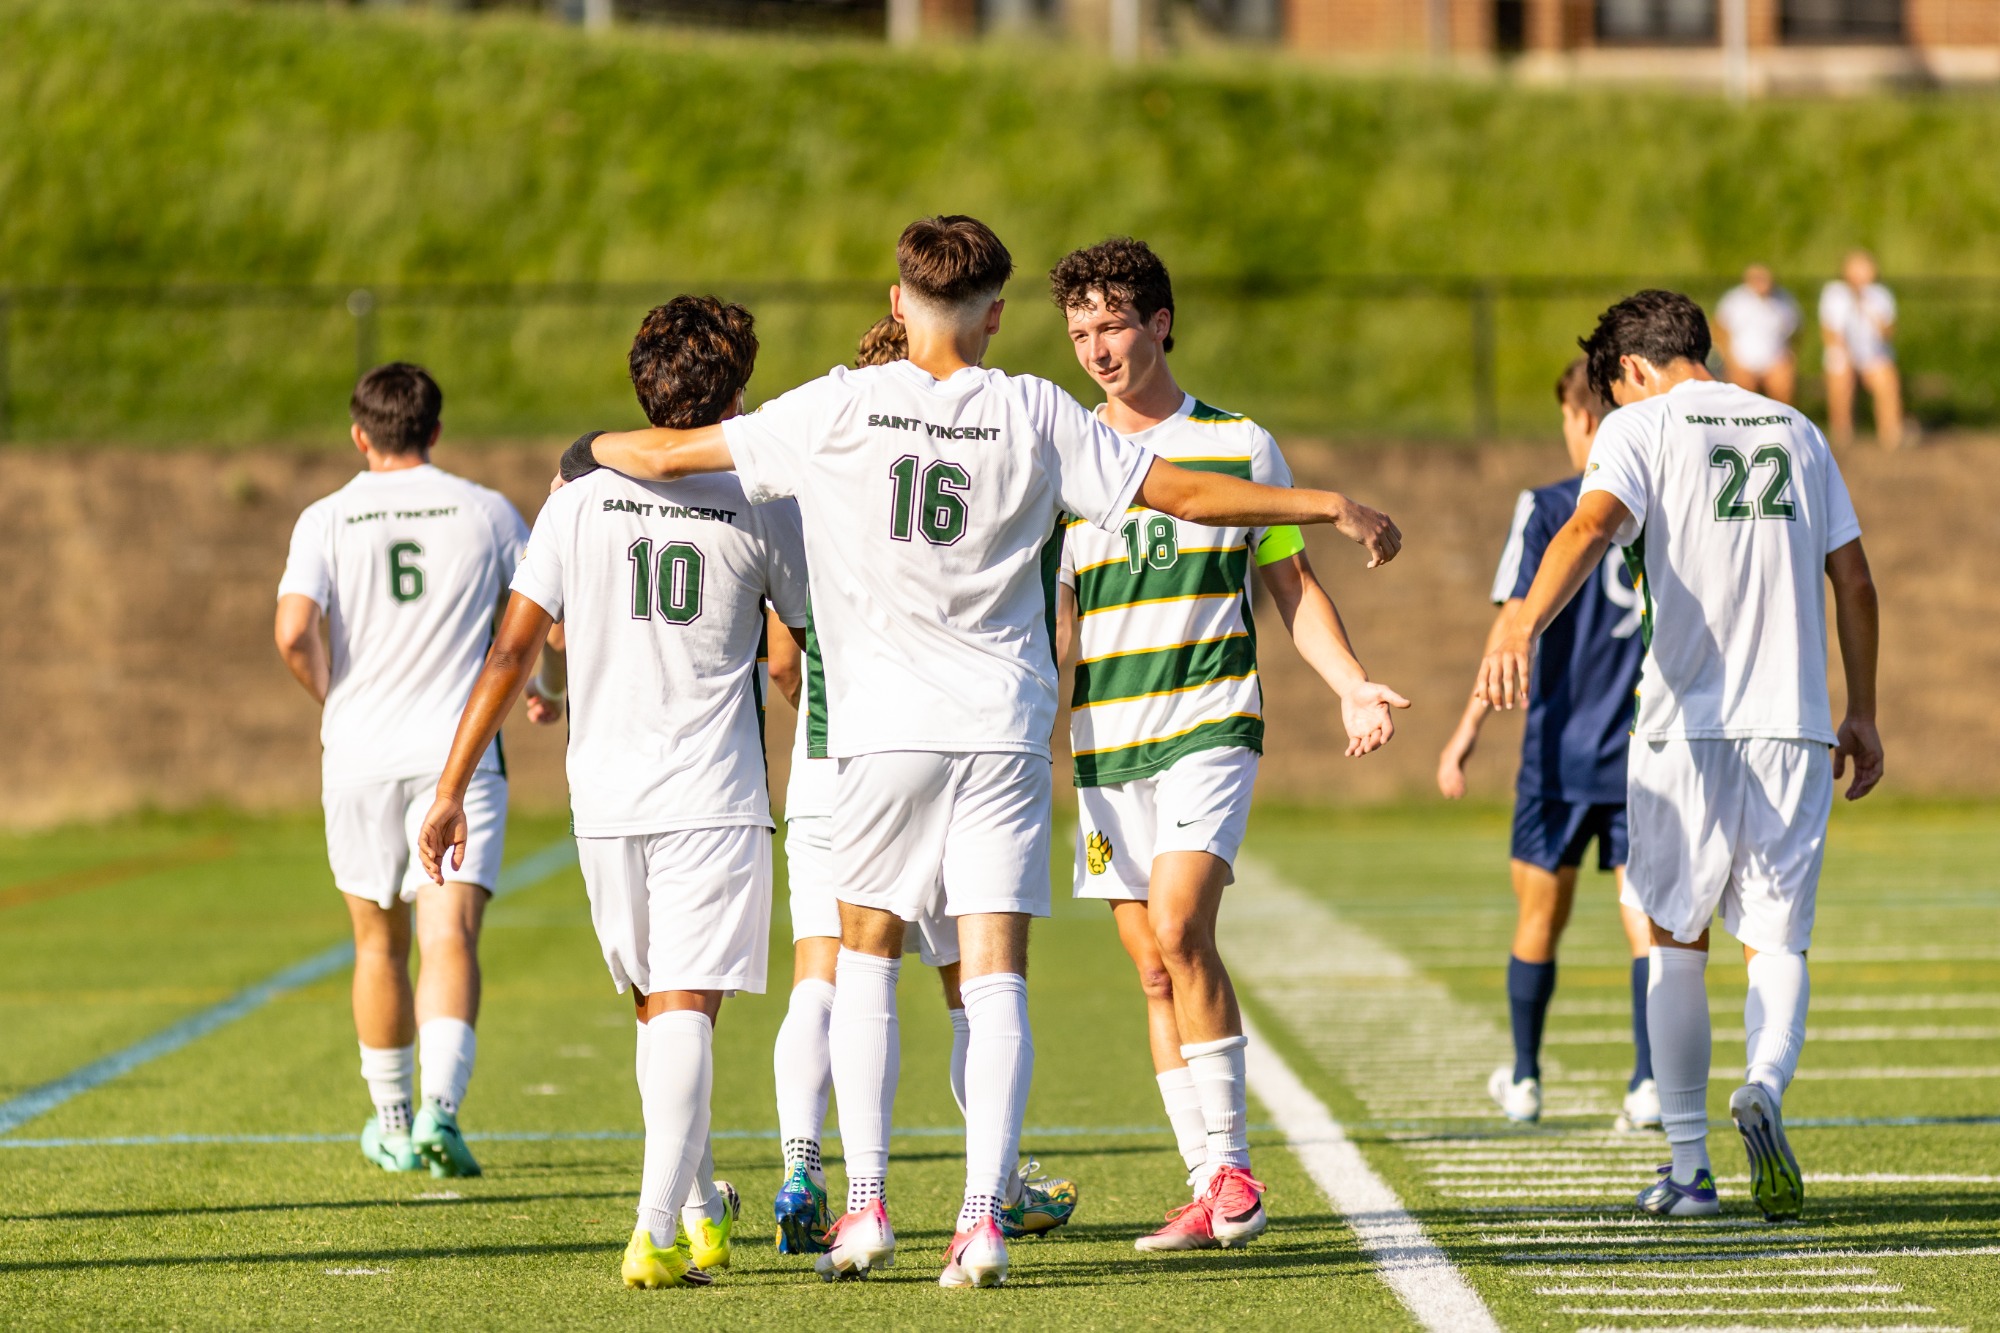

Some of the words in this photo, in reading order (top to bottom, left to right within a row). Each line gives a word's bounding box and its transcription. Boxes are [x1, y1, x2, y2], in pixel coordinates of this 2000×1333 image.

[868, 414, 921, 431] SAINT
[925, 422, 1001, 441] VINCENT
[1685, 415, 1726, 427] SAINT
[1731, 415, 1793, 427] VINCENT
[603, 499, 653, 517] SAINT
[658, 505, 737, 524] VINCENT
[889, 454, 970, 546] 16
[1709, 443, 1796, 521] 22
[386, 538, 426, 608] 6
[1121, 514, 1179, 575] 18
[628, 537, 705, 626] 10
